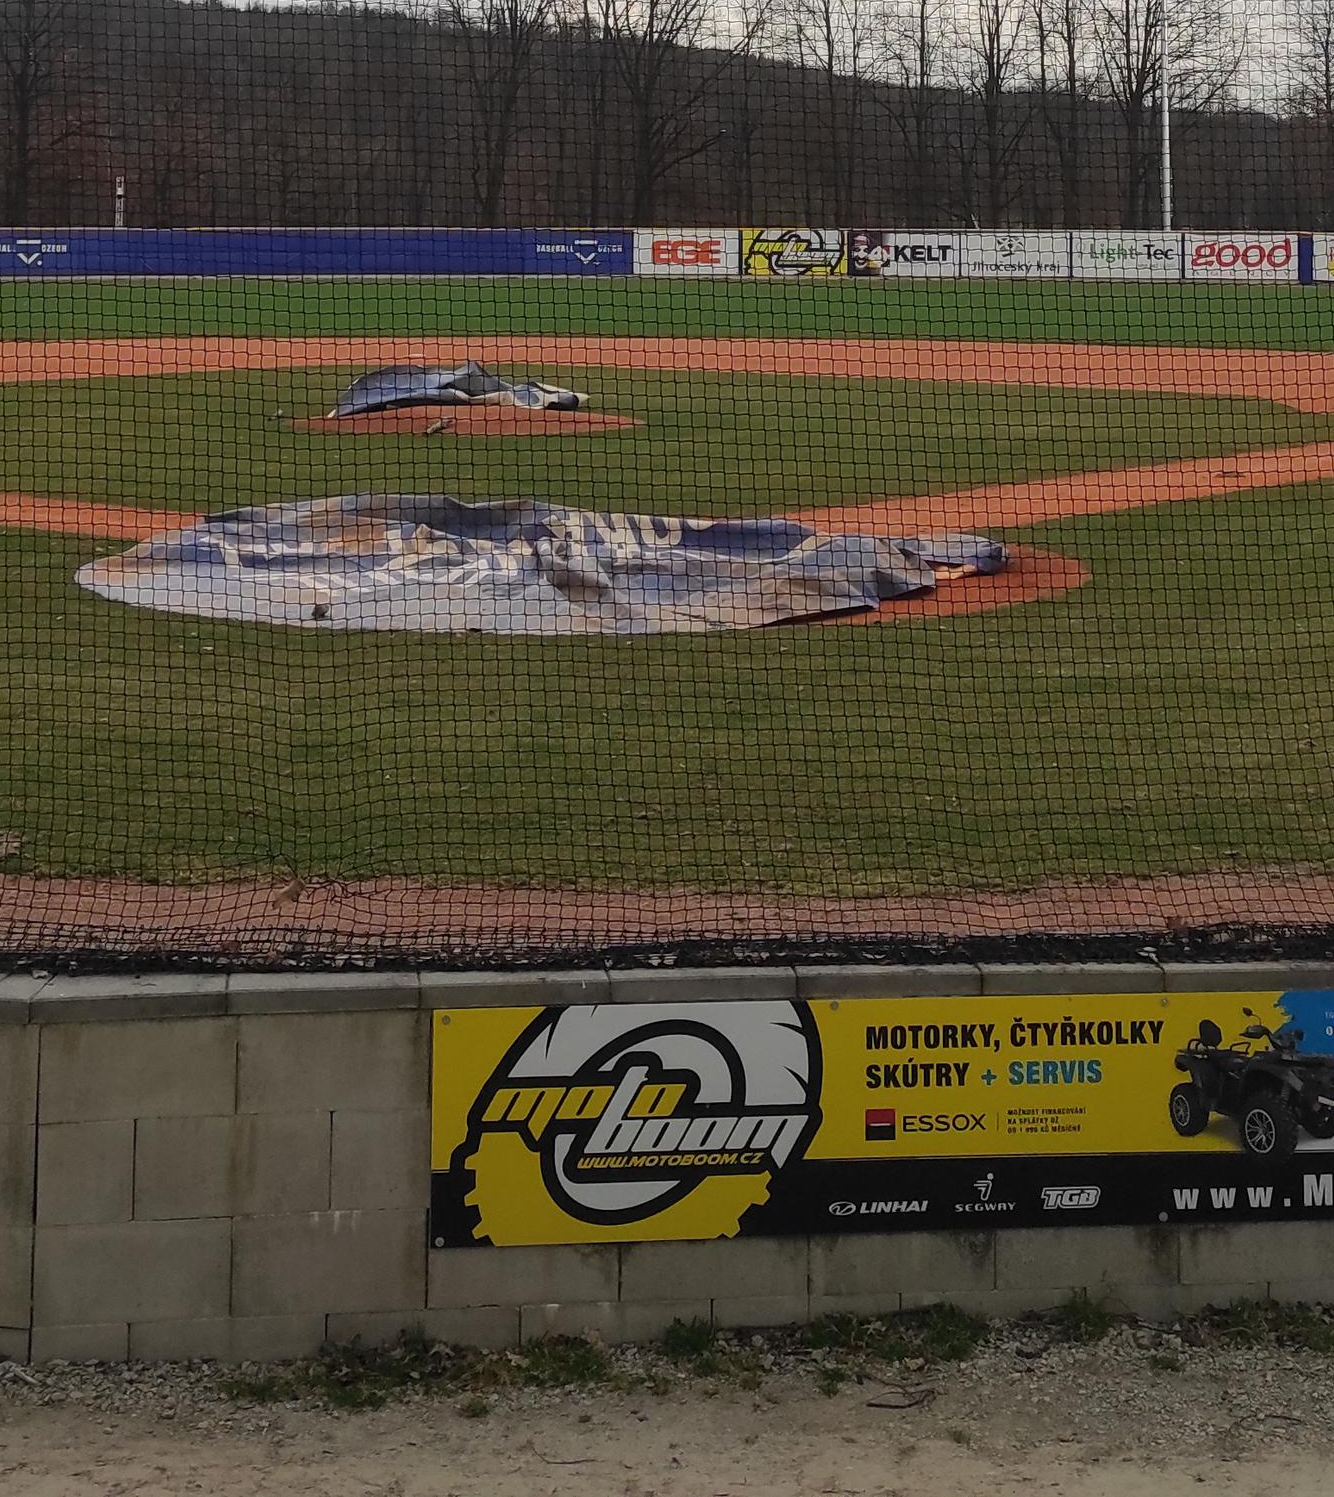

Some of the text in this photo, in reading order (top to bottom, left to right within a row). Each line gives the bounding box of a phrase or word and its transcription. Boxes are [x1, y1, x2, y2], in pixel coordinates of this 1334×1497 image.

[894, 244, 953, 262] KELT
[1191, 238, 1292, 268] good
[1036, 259, 1061, 274] kraj
[865, 1015, 1165, 1054] MOTORKY, ČTYŘKOLKY
[865, 1056, 970, 1090] SKÚTRY
[1007, 1060, 1104, 1087] SERVIS
[584, 1066, 809, 1168] boom
[902, 1113, 987, 1133] ESSOX
[859, 1200, 929, 1214] LINHAI
[954, 1201, 1017, 1213] SEGWAY
[1043, 1187, 1100, 1209] TGB
